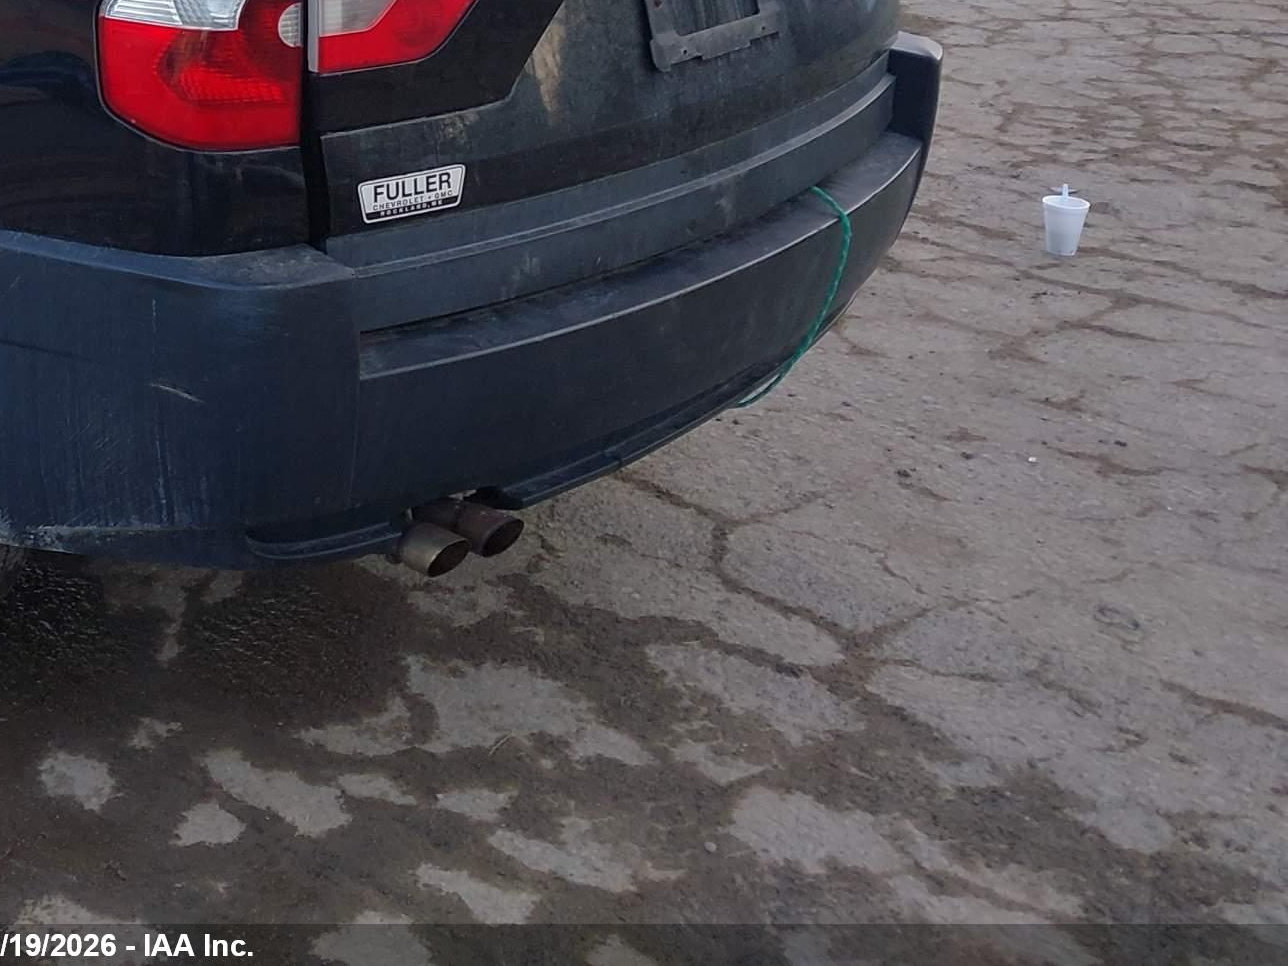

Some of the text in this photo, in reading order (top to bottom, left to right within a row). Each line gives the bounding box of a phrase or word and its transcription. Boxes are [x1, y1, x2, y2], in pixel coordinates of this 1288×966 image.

[372, 189, 453, 211] CHEVROLET GMC
[373, 171, 452, 204] FULLER
